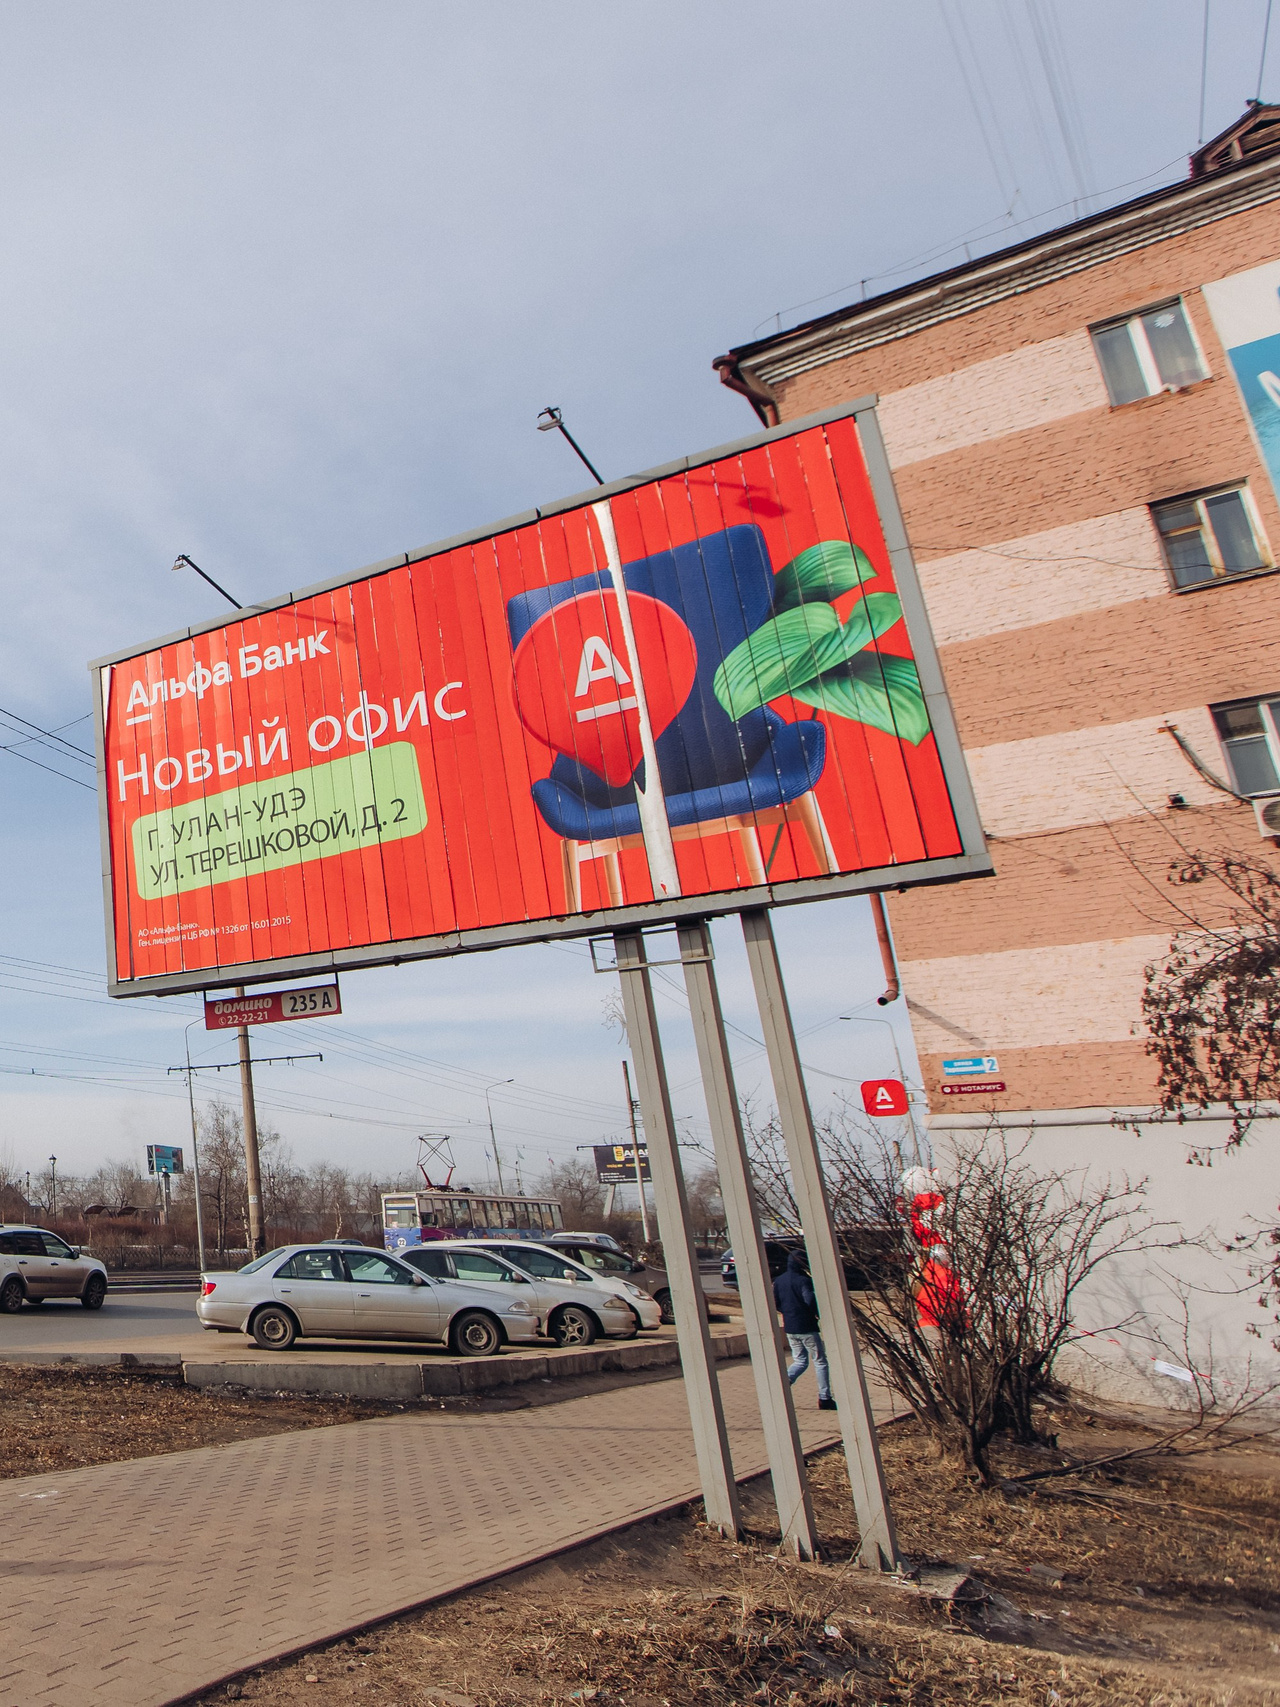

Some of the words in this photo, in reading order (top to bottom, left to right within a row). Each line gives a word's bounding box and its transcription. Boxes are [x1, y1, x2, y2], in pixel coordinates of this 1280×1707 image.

[126, 661, 232, 714] Альфа
[238, 630, 331, 679] Банк
[117, 716, 289, 801] Новый
[308, 681, 468, 751] офис
[148, 827, 164, 851] Г.
[170, 787, 307, 845] УЛАН-УДЭ
[150, 858, 184, 885] УЛ.
[185, 809, 356, 876] ТЕРЕШКОВОЙ,
[361, 804, 387, 836] Д.
[390, 798, 408, 823] 2
[137, 928, 149, 937] АО
[138, 938, 152, 947] Ген.
[152, 933, 187, 946] лицензия
[187, 930, 198, 941] ЦБ
[199, 929, 210, 939] РФ
[210, 927, 219, 937] №
[221, 924, 239, 935] 1326
[239, 923, 248, 932] от
[250, 916, 292, 930] 16.01.2015
[214, 998, 273, 1015] домино
[289, 993, 318, 1013] 235
[321, 991, 333, 1009] А
[227, 1011, 269, 1025] 22-22-21
[986, 1058, 998, 1071] 2
[960, 1083, 1003, 1092] НОТАРИУС
